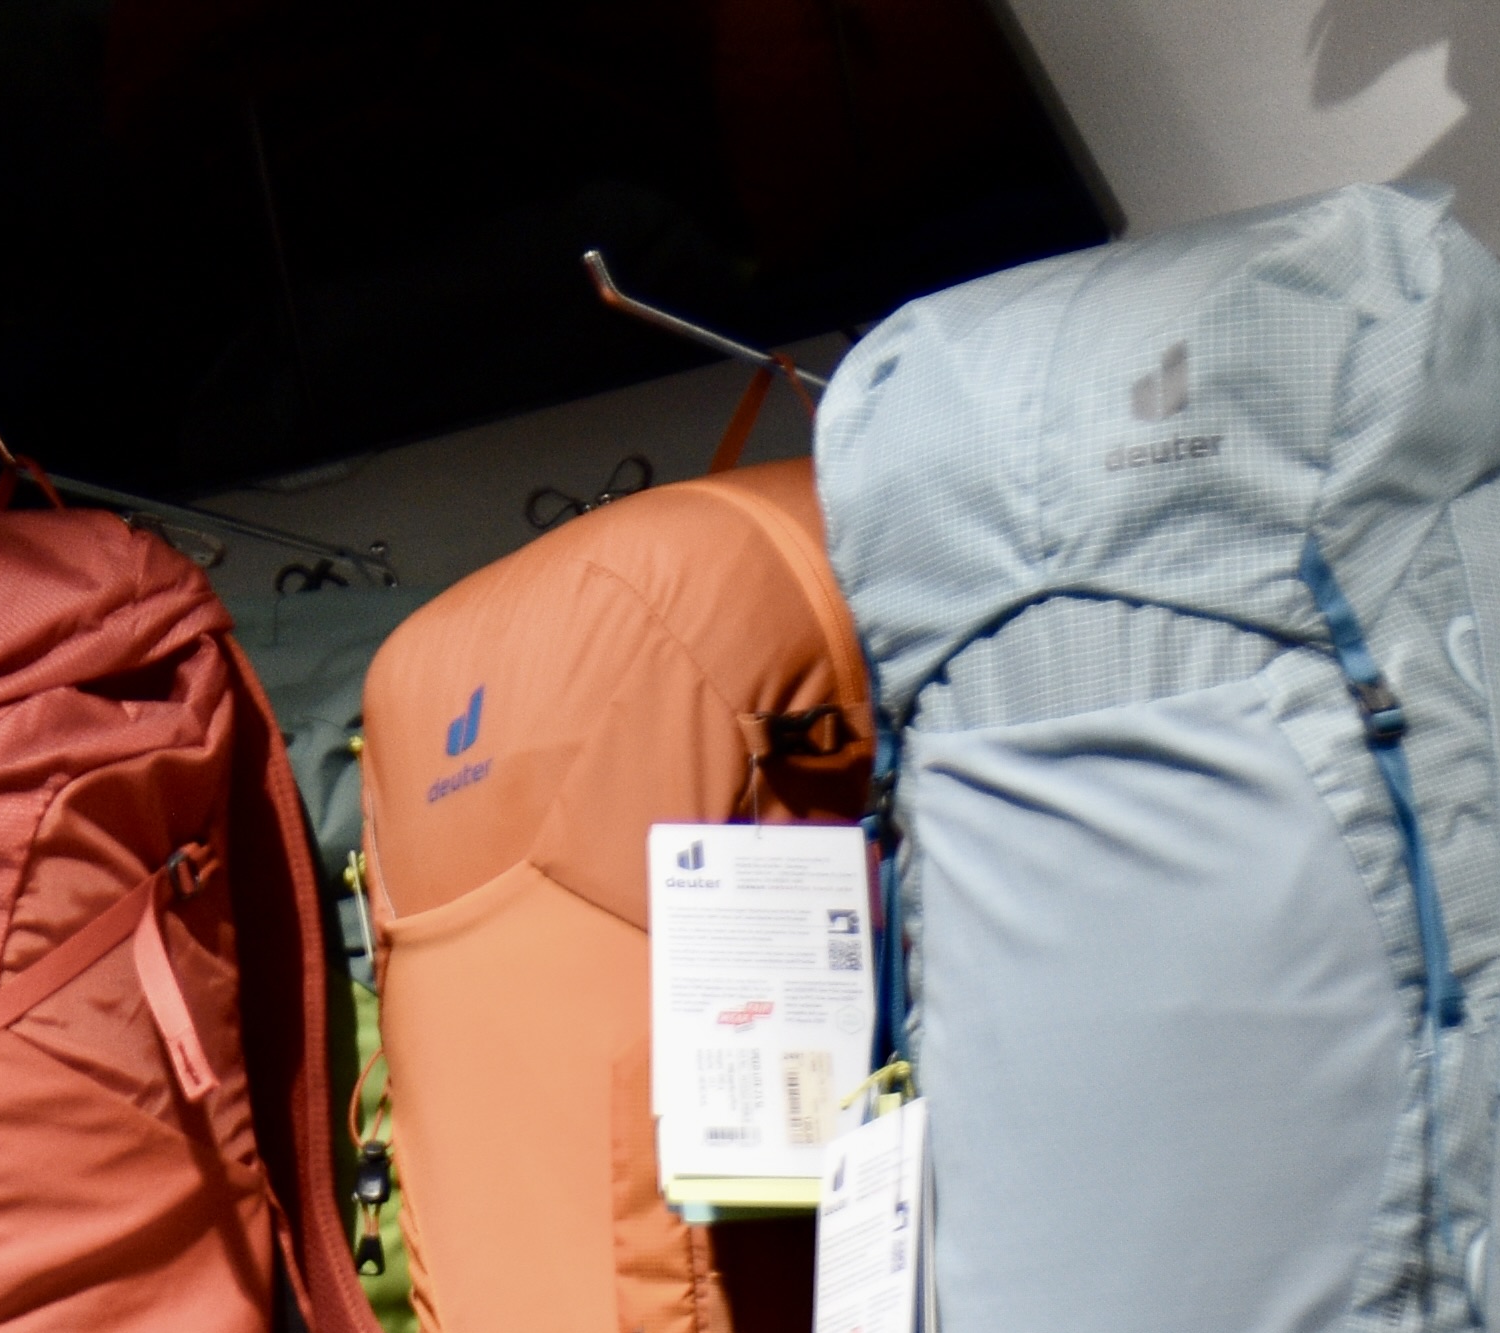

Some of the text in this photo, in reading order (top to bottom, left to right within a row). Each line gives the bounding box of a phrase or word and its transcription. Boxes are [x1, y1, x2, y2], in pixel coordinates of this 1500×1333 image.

[1103, 430, 1223, 473] deuter
[426, 755, 494, 806] deuter
[665, 876, 722, 890] deuter
